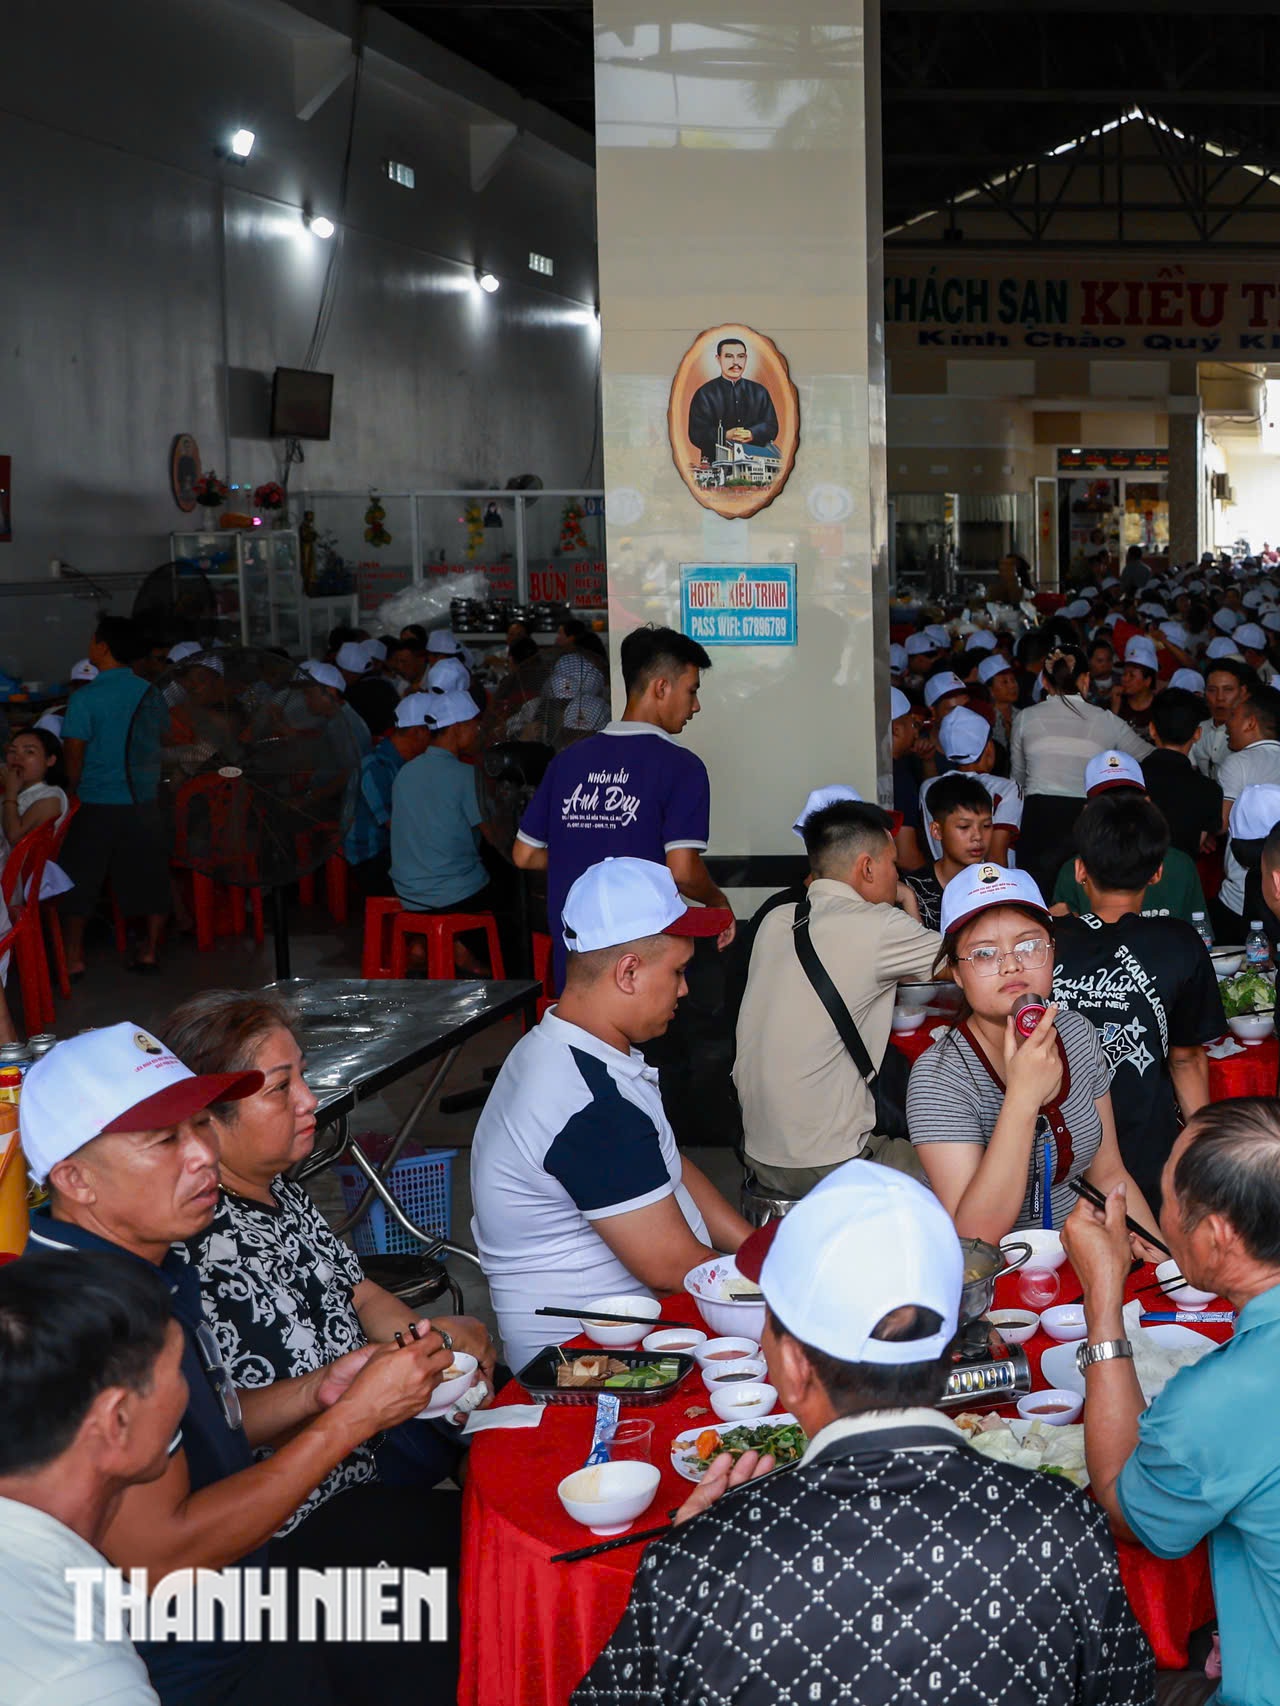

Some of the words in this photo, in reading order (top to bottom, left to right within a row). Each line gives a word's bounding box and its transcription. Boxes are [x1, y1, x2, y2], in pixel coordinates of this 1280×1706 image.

[884, 266, 988, 324] HÁCH
[1081, 264, 1229, 327] KIỀU
[918, 328, 1009, 348] Kính
[1025, 328, 1125, 349] Chào
[1143, 331, 1220, 353] Quý
[755, 582, 787, 608] TRINH
[691, 616, 716, 636] PASS
[743, 617, 787, 637] 67896789
[562, 783, 600, 814] Anh
[1078, 1000, 1103, 1009] PONT
[1105, 1000, 1130, 1012] NEUF
[1087, 991, 1127, 1001] FRANCE
